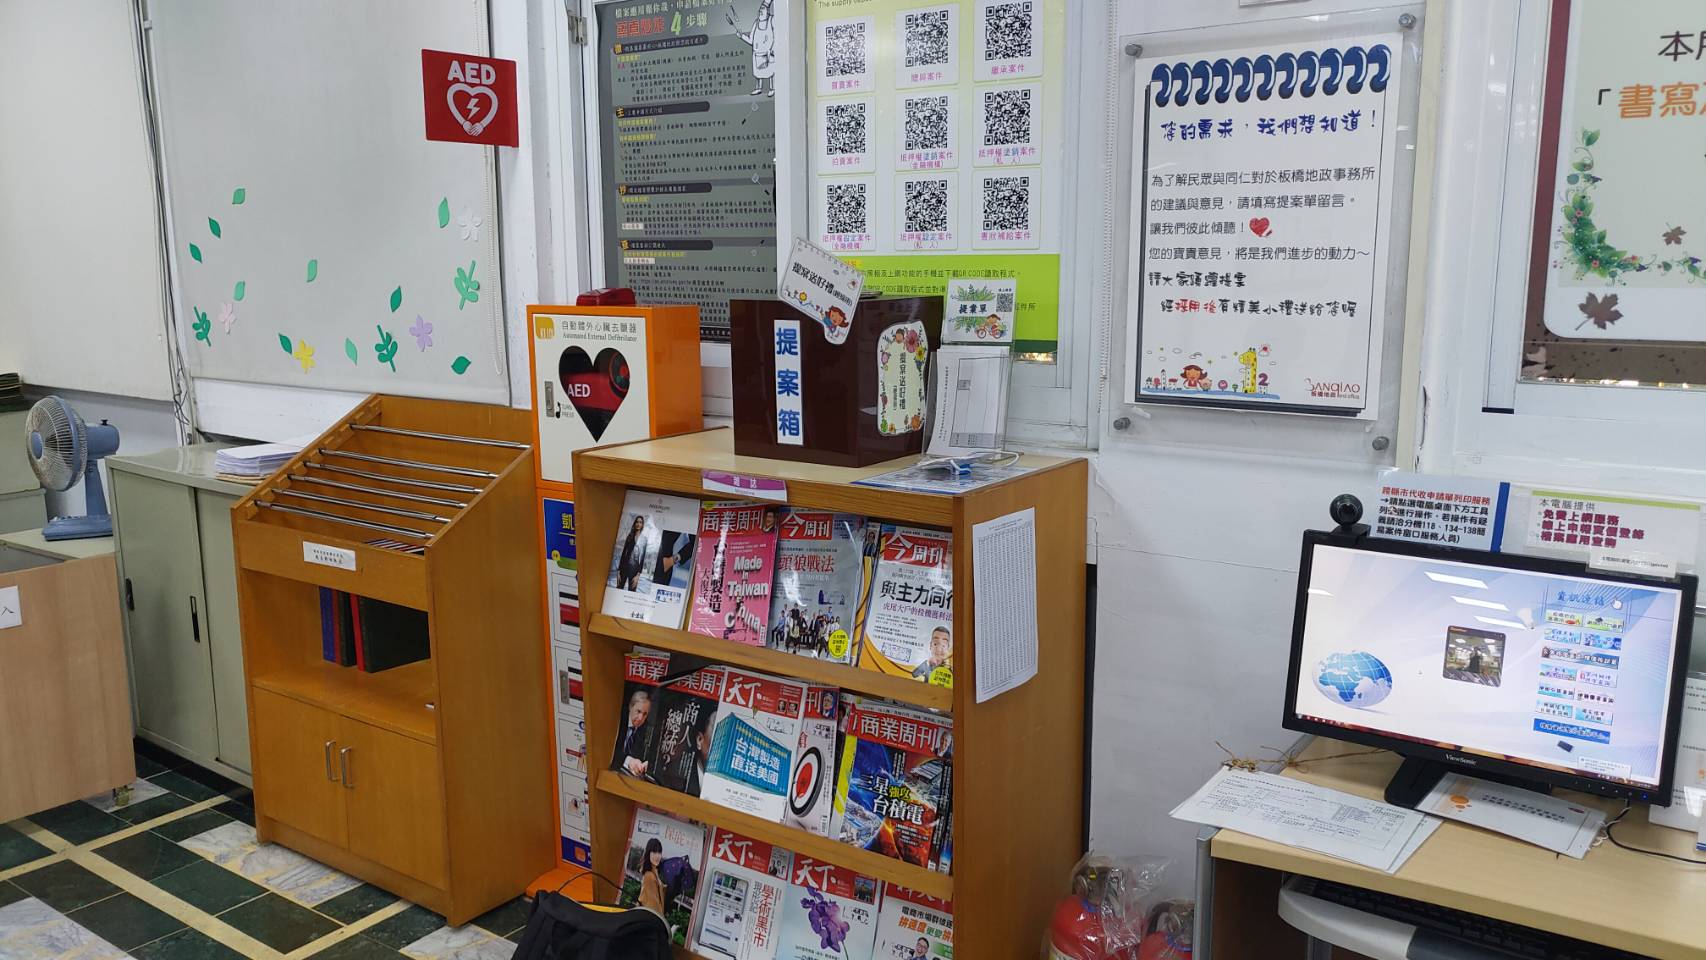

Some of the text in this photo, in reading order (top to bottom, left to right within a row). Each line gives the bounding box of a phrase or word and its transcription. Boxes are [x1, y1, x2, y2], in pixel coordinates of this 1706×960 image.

[447, 60, 496, 85] AED
[1597, 81, 1706, 119] 「書寫
[1151, 166, 1375, 187] 為了解民眾與同仁對於板橋地政事務所
[1150, 194, 1355, 211] 的建議與意見，請填寫提案單留言。
[1148, 271, 1247, 287] 請大家踴躍提案
[567, 384, 591, 398] AED
[775, 327, 800, 437] 提案箱
[1539, 498, 1595, 511] 本電腦提供
[1543, 508, 1620, 526] 免費上網服務
[702, 509, 764, 532] 商業周刊
[782, 513, 831, 538] 今周刊
[778, 553, 835, 574] 頭狼戰法
[886, 532, 946, 570] 今周刊
[734, 556, 763, 573] Made
[727, 580, 769, 600] Taiwan
[628, 658, 669, 682] 商業
[726, 677, 763, 710] 天下
[678, 702, 701, 748] 商人
[860, 713, 938, 753] 商業周刊
[735, 737, 781, 771] 台灣製造
[1446, 753, 1478, 767] ViewSonic
[730, 753, 780, 786] 直送美國
[873, 794, 925, 825] 台積電
[715, 833, 753, 866] 天下
[794, 858, 836, 891] 天下
[753, 883, 775, 948] 學術黑市
